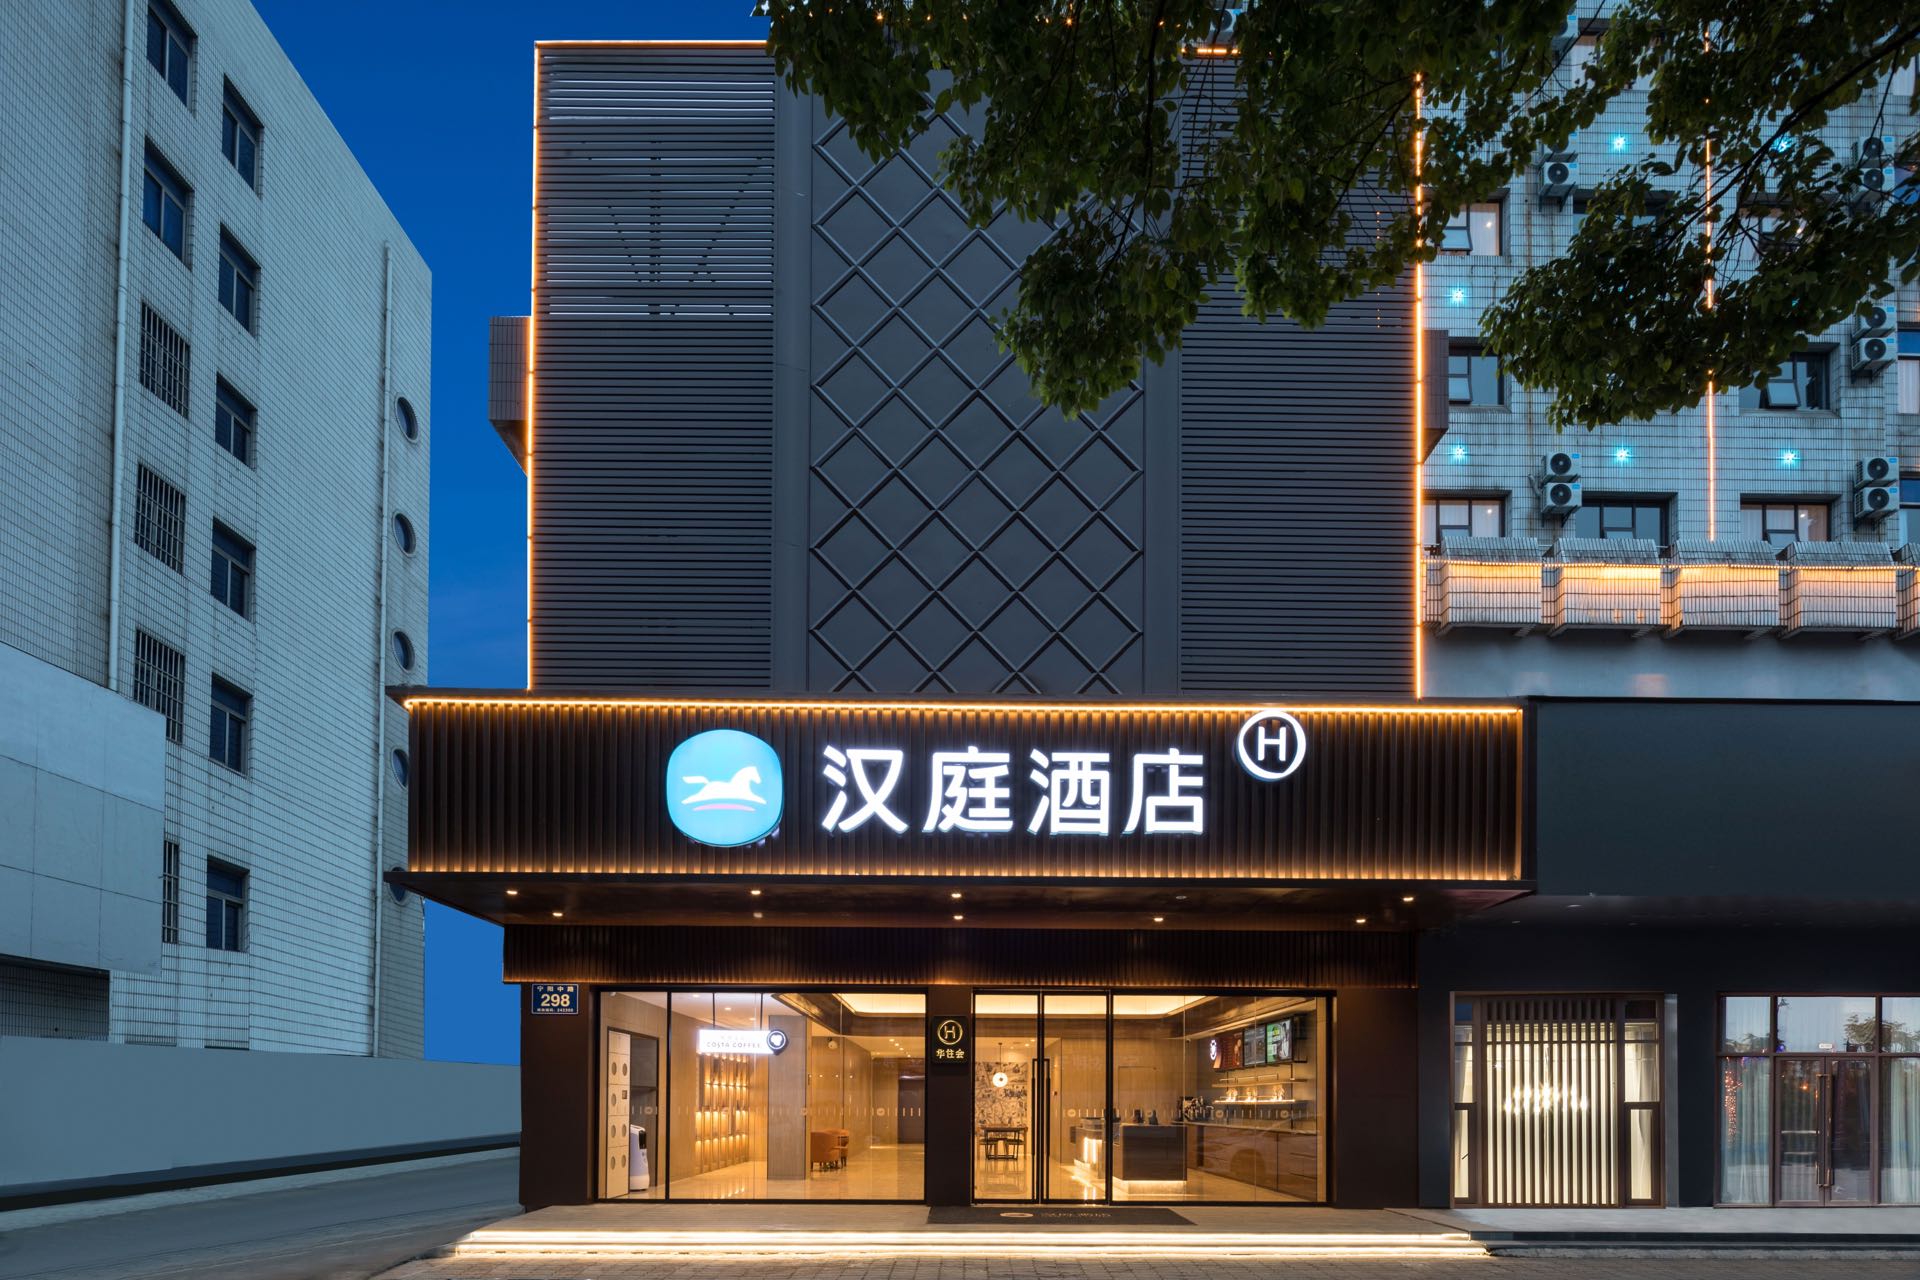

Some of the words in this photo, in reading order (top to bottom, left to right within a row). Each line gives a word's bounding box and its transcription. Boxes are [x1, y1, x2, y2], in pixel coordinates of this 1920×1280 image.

[821, 745, 1204, 836] 汉庭酒店
[541, 994, 570, 1007] 298
[706, 1041, 730, 1049] COSTA
[936, 1048, 965, 1059] 华住会
